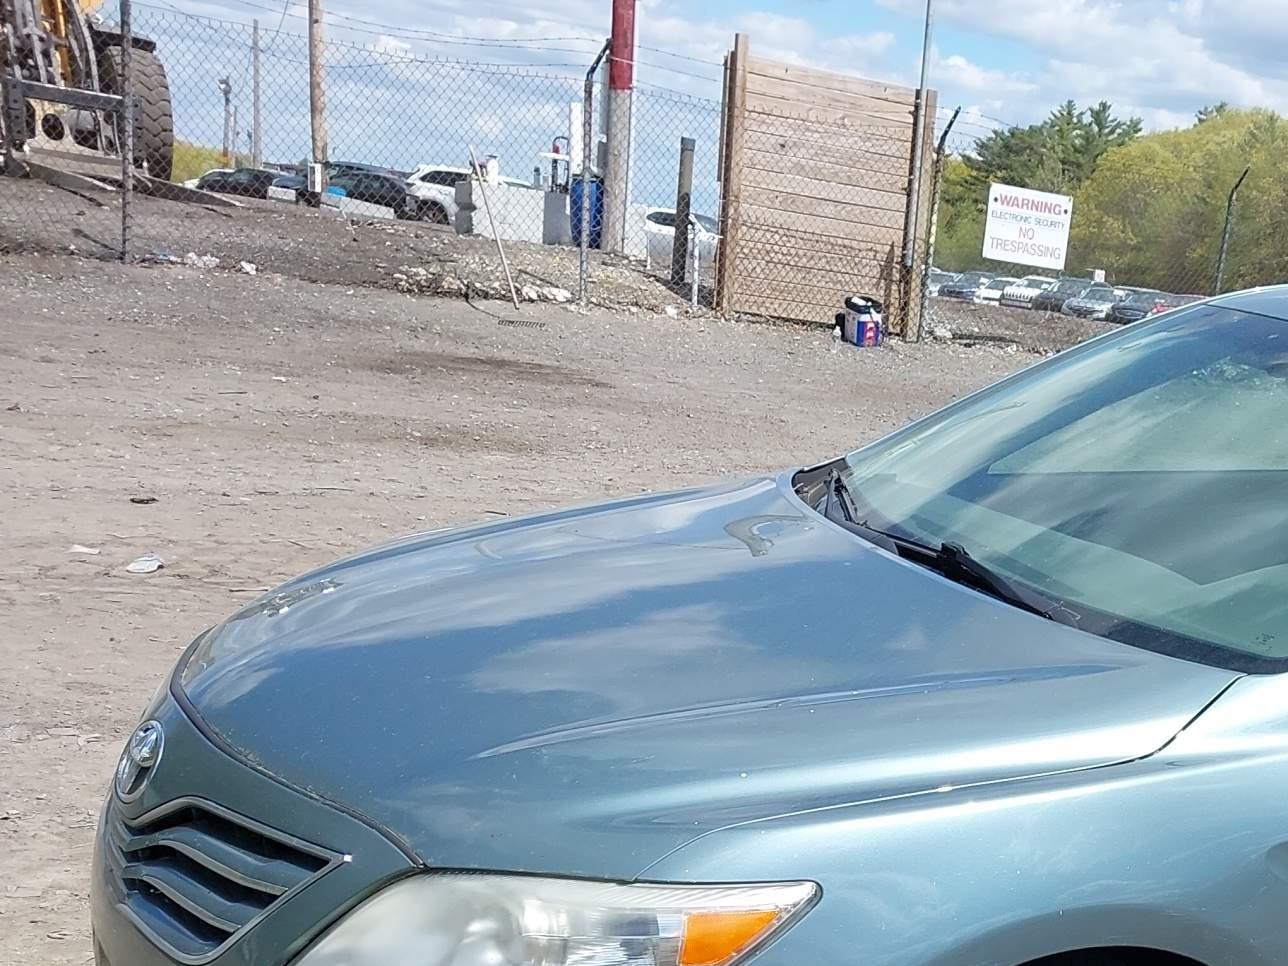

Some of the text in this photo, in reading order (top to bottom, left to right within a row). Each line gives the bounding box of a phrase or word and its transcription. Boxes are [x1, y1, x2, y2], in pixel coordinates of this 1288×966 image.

[999, 193, 1062, 216] WARNING
[991, 210, 1065, 230] ELECTRONIC SECURITY
[1018, 226, 1035, 240] NO
[990, 236, 1062, 260] TRESPASSING
